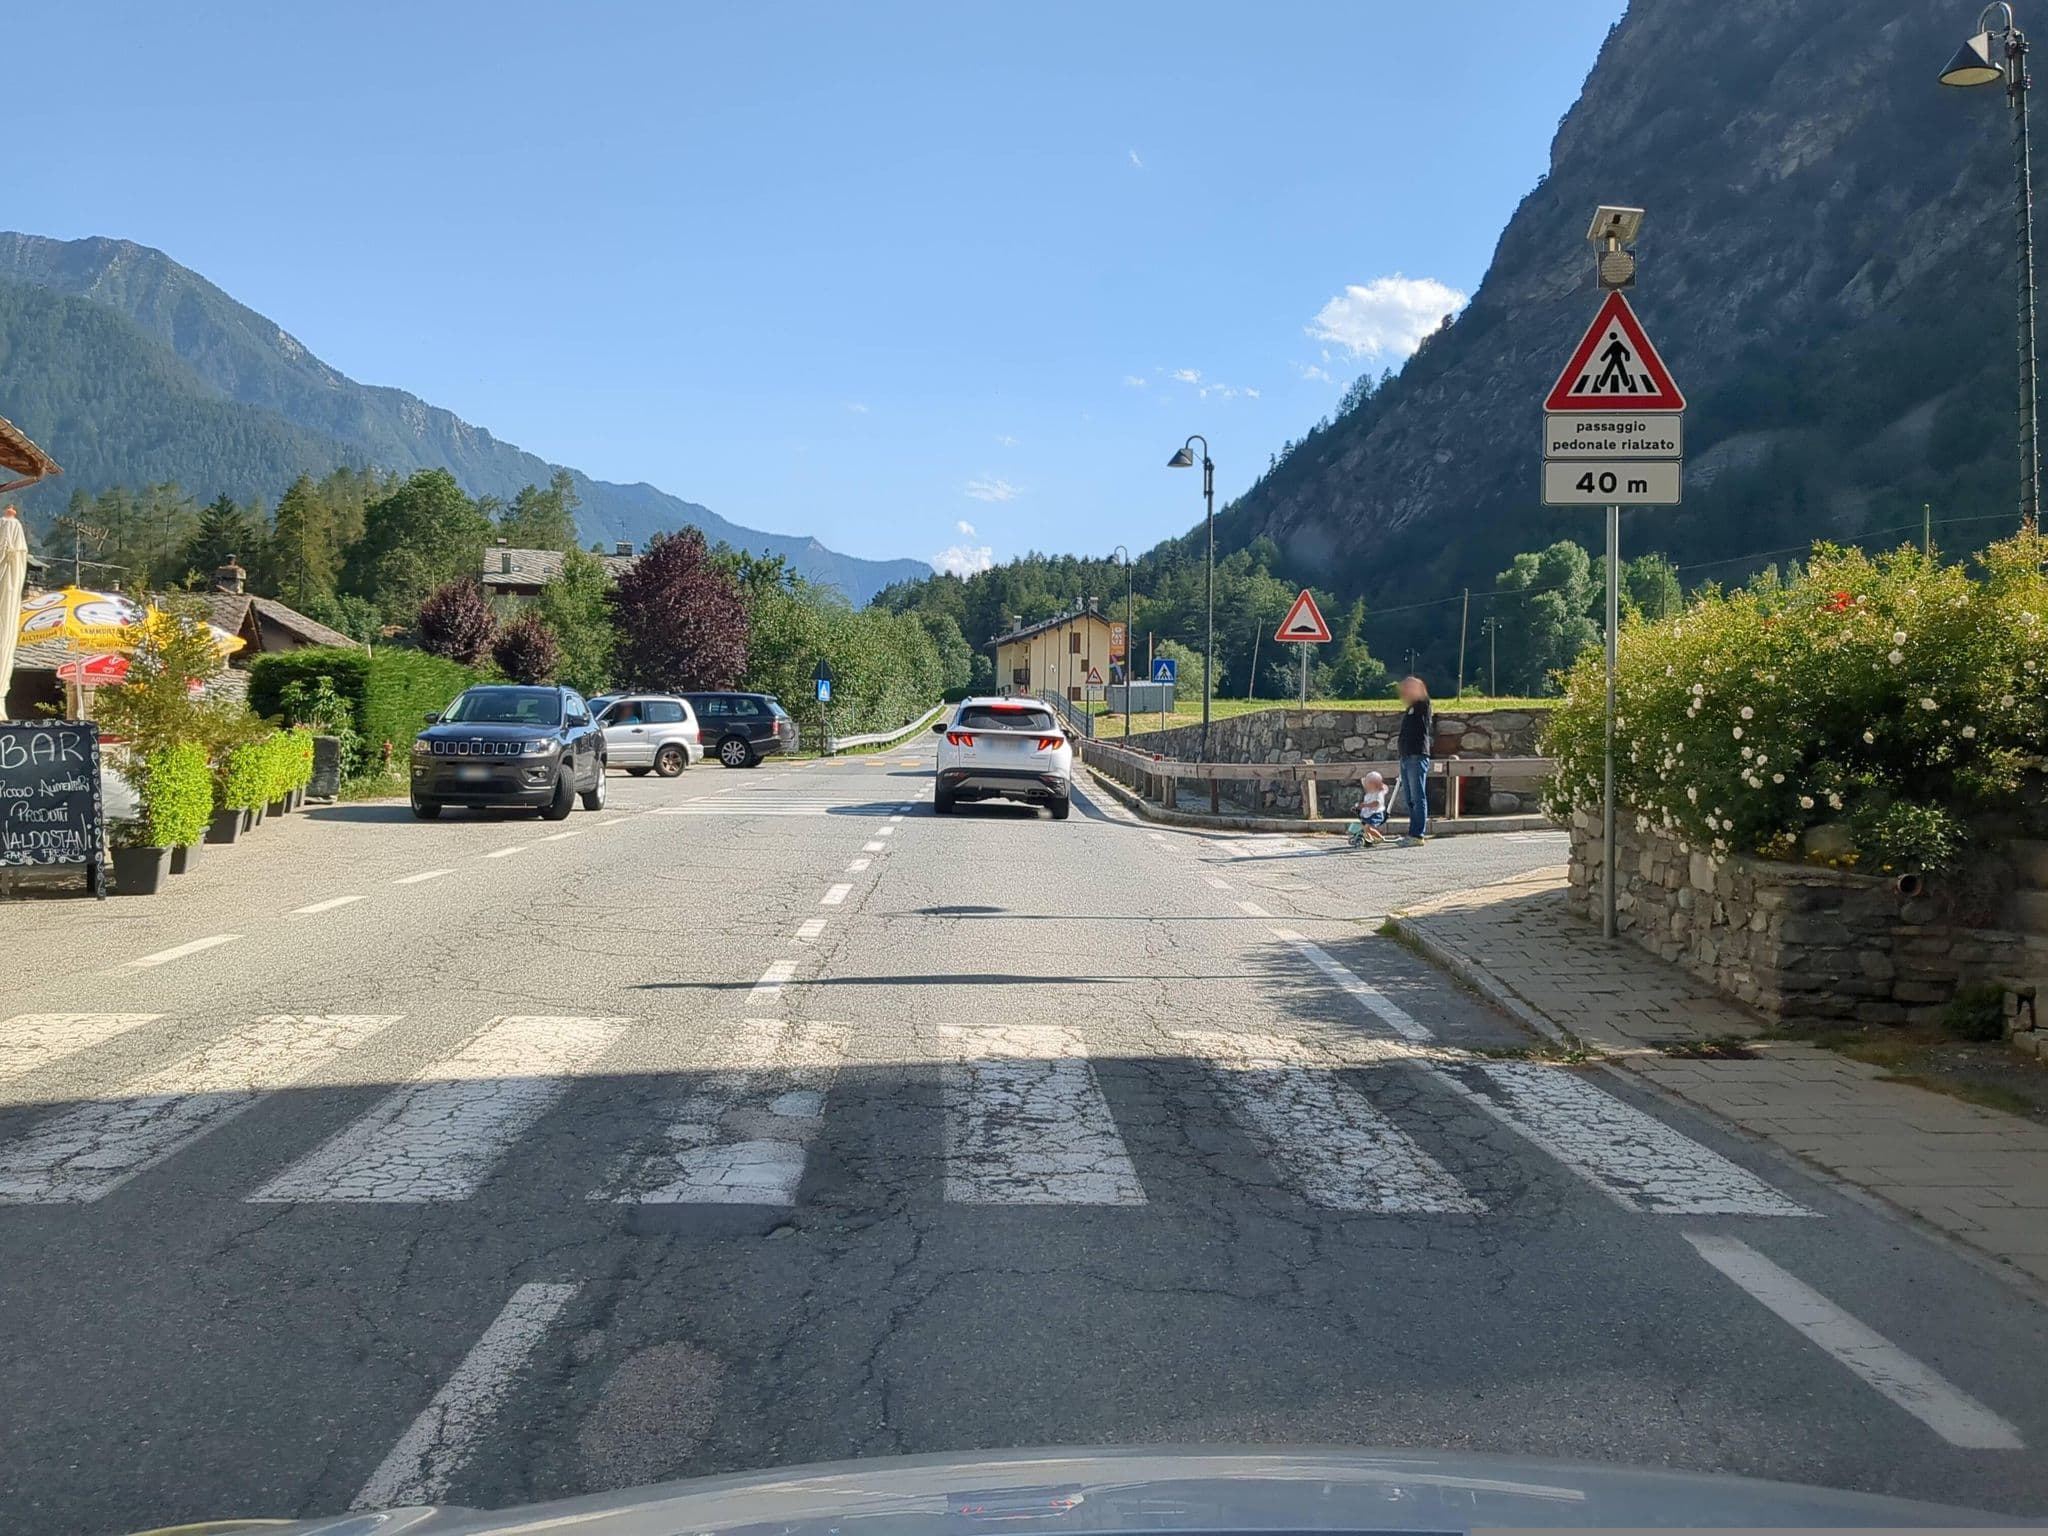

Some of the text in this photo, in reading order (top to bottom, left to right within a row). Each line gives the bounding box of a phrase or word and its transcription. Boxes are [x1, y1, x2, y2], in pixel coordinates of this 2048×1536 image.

[1576, 421, 1647, 433] passaggio
[1553, 439, 1675, 451] pedonale rialzato
[1576, 472, 1648, 494] 40 m
[0, 732, 84, 769] BAR
